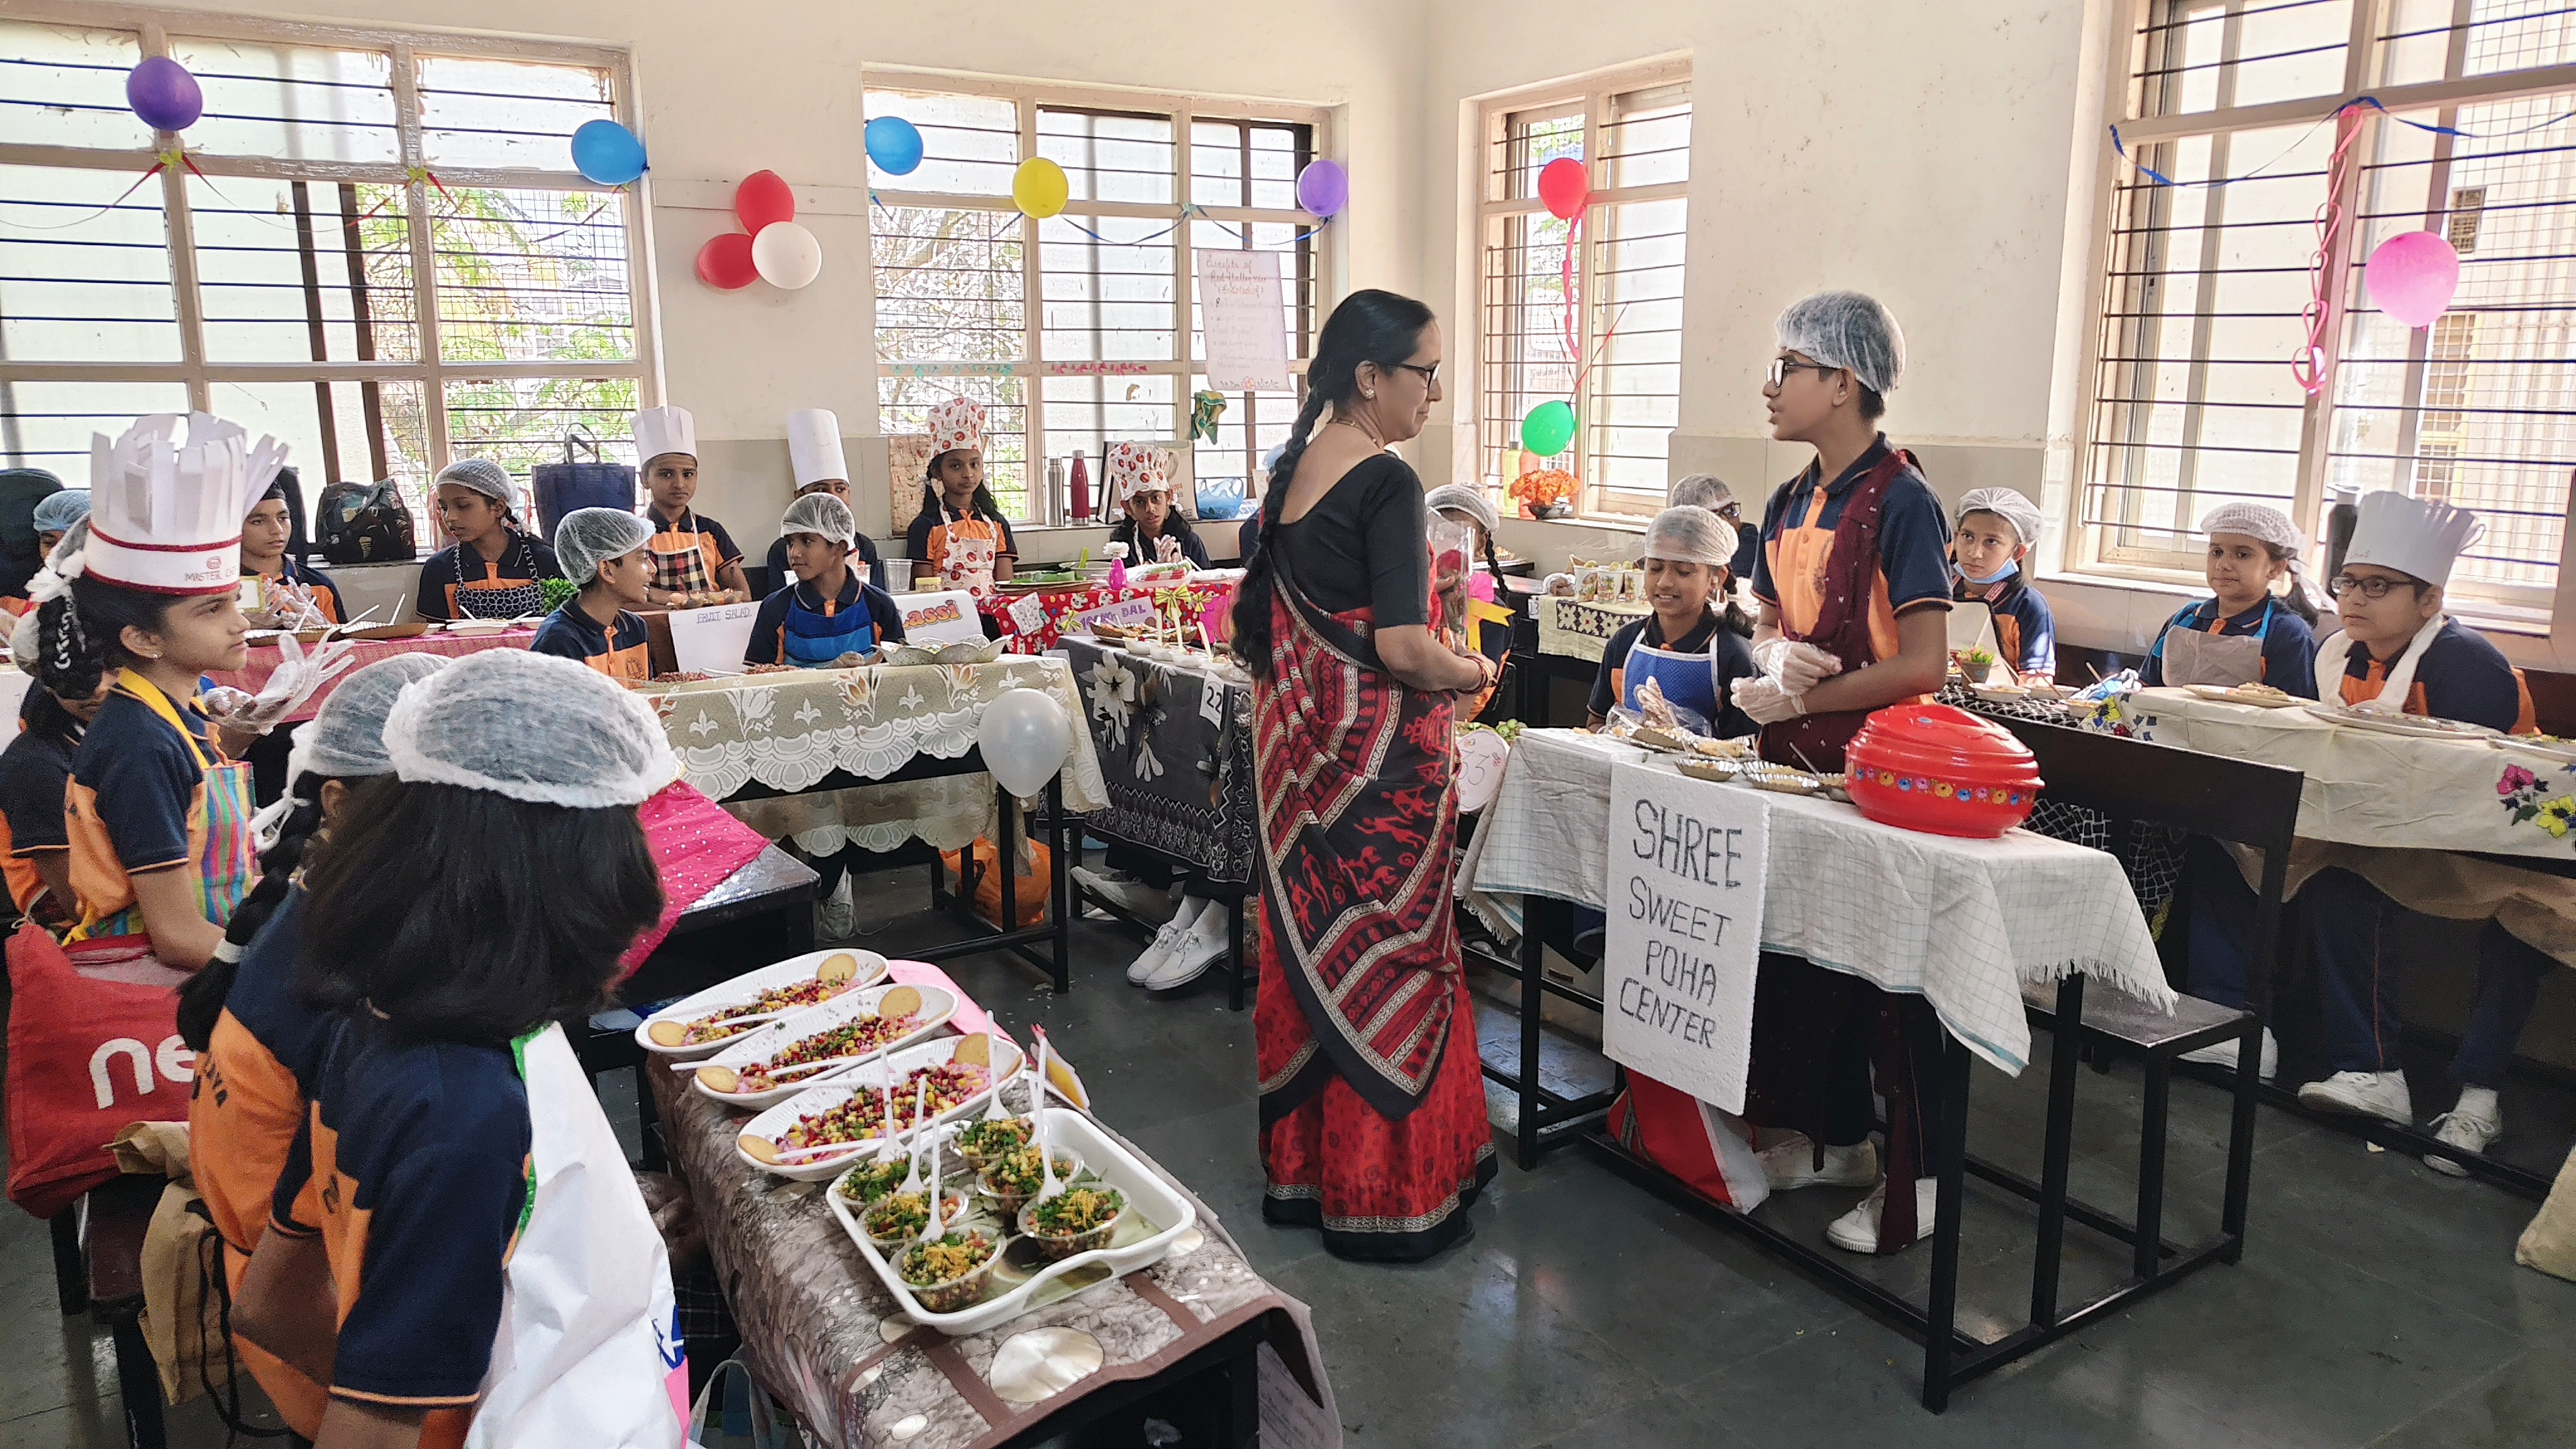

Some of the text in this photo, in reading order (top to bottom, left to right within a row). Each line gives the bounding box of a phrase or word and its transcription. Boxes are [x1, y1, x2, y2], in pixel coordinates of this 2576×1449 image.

[1243, 260, 1252, 274] of
[184, 570, 223, 582] MASTER
[697, 608, 752, 623] FRUIT SALAD
[902, 599, 962, 630] assi
[1121, 604, 1146, 618] DAL
[1206, 686, 1222, 715] 22
[1633, 799, 1742, 887] SHREE
[1629, 875, 1731, 947] SWEET
[1645, 940, 1717, 1006] POHA
[1620, 977, 1716, 1048] CENTER
[89, 1033, 197, 1110] ne
